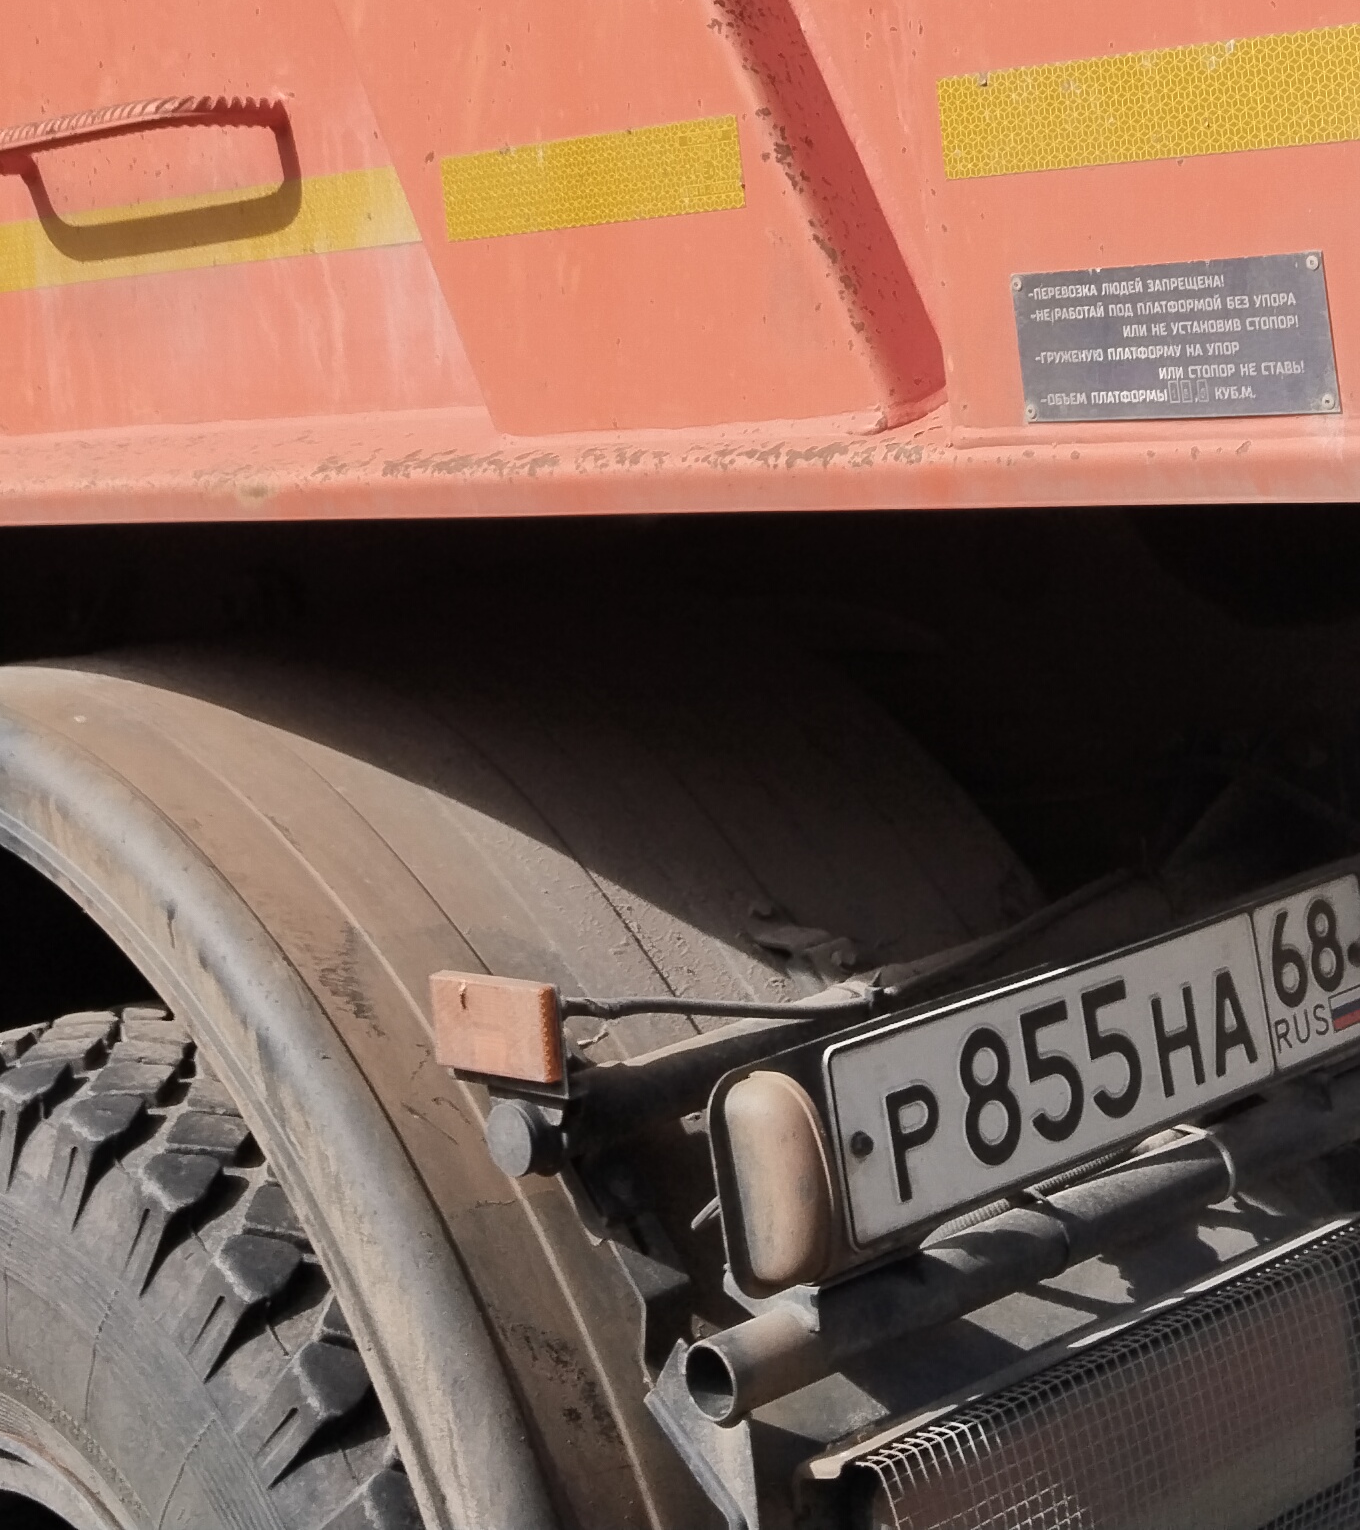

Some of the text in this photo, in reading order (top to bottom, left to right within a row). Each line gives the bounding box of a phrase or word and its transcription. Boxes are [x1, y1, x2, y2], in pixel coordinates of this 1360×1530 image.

[1101, 276, 1143, 297] ЛЮДЕЙ
[1147, 274, 1225, 293] ЗАПРЕЩЕНА!
[1053, 302, 1104, 319] РАБОТАЙ
[1109, 304, 1133, 318] ПОД
[1137, 296, 1222, 315] ПЛАТФОРМОЙ
[1227, 296, 1249, 310] БЕЗ
[1254, 294, 1296, 308] УПОРА
[1123, 315, 1299, 338] ИЛИ НЕ УСТАНОВИВ СТОПОР!
[1108, 343, 1181, 362] ПЛАТФОРМУ
[1186, 343, 1203, 357] НА
[1207, 341, 1239, 356] УПОР
[1159, 359, 1305, 380] ИЛИ СТОПОР НЕ СТАВЬ!
[1091, 387, 1168, 404] ПЛАТФОРМЫ
[1275, 1004, 1330, 1055] RUS
[885, 898, 1345, 1204] Р855НА 68
